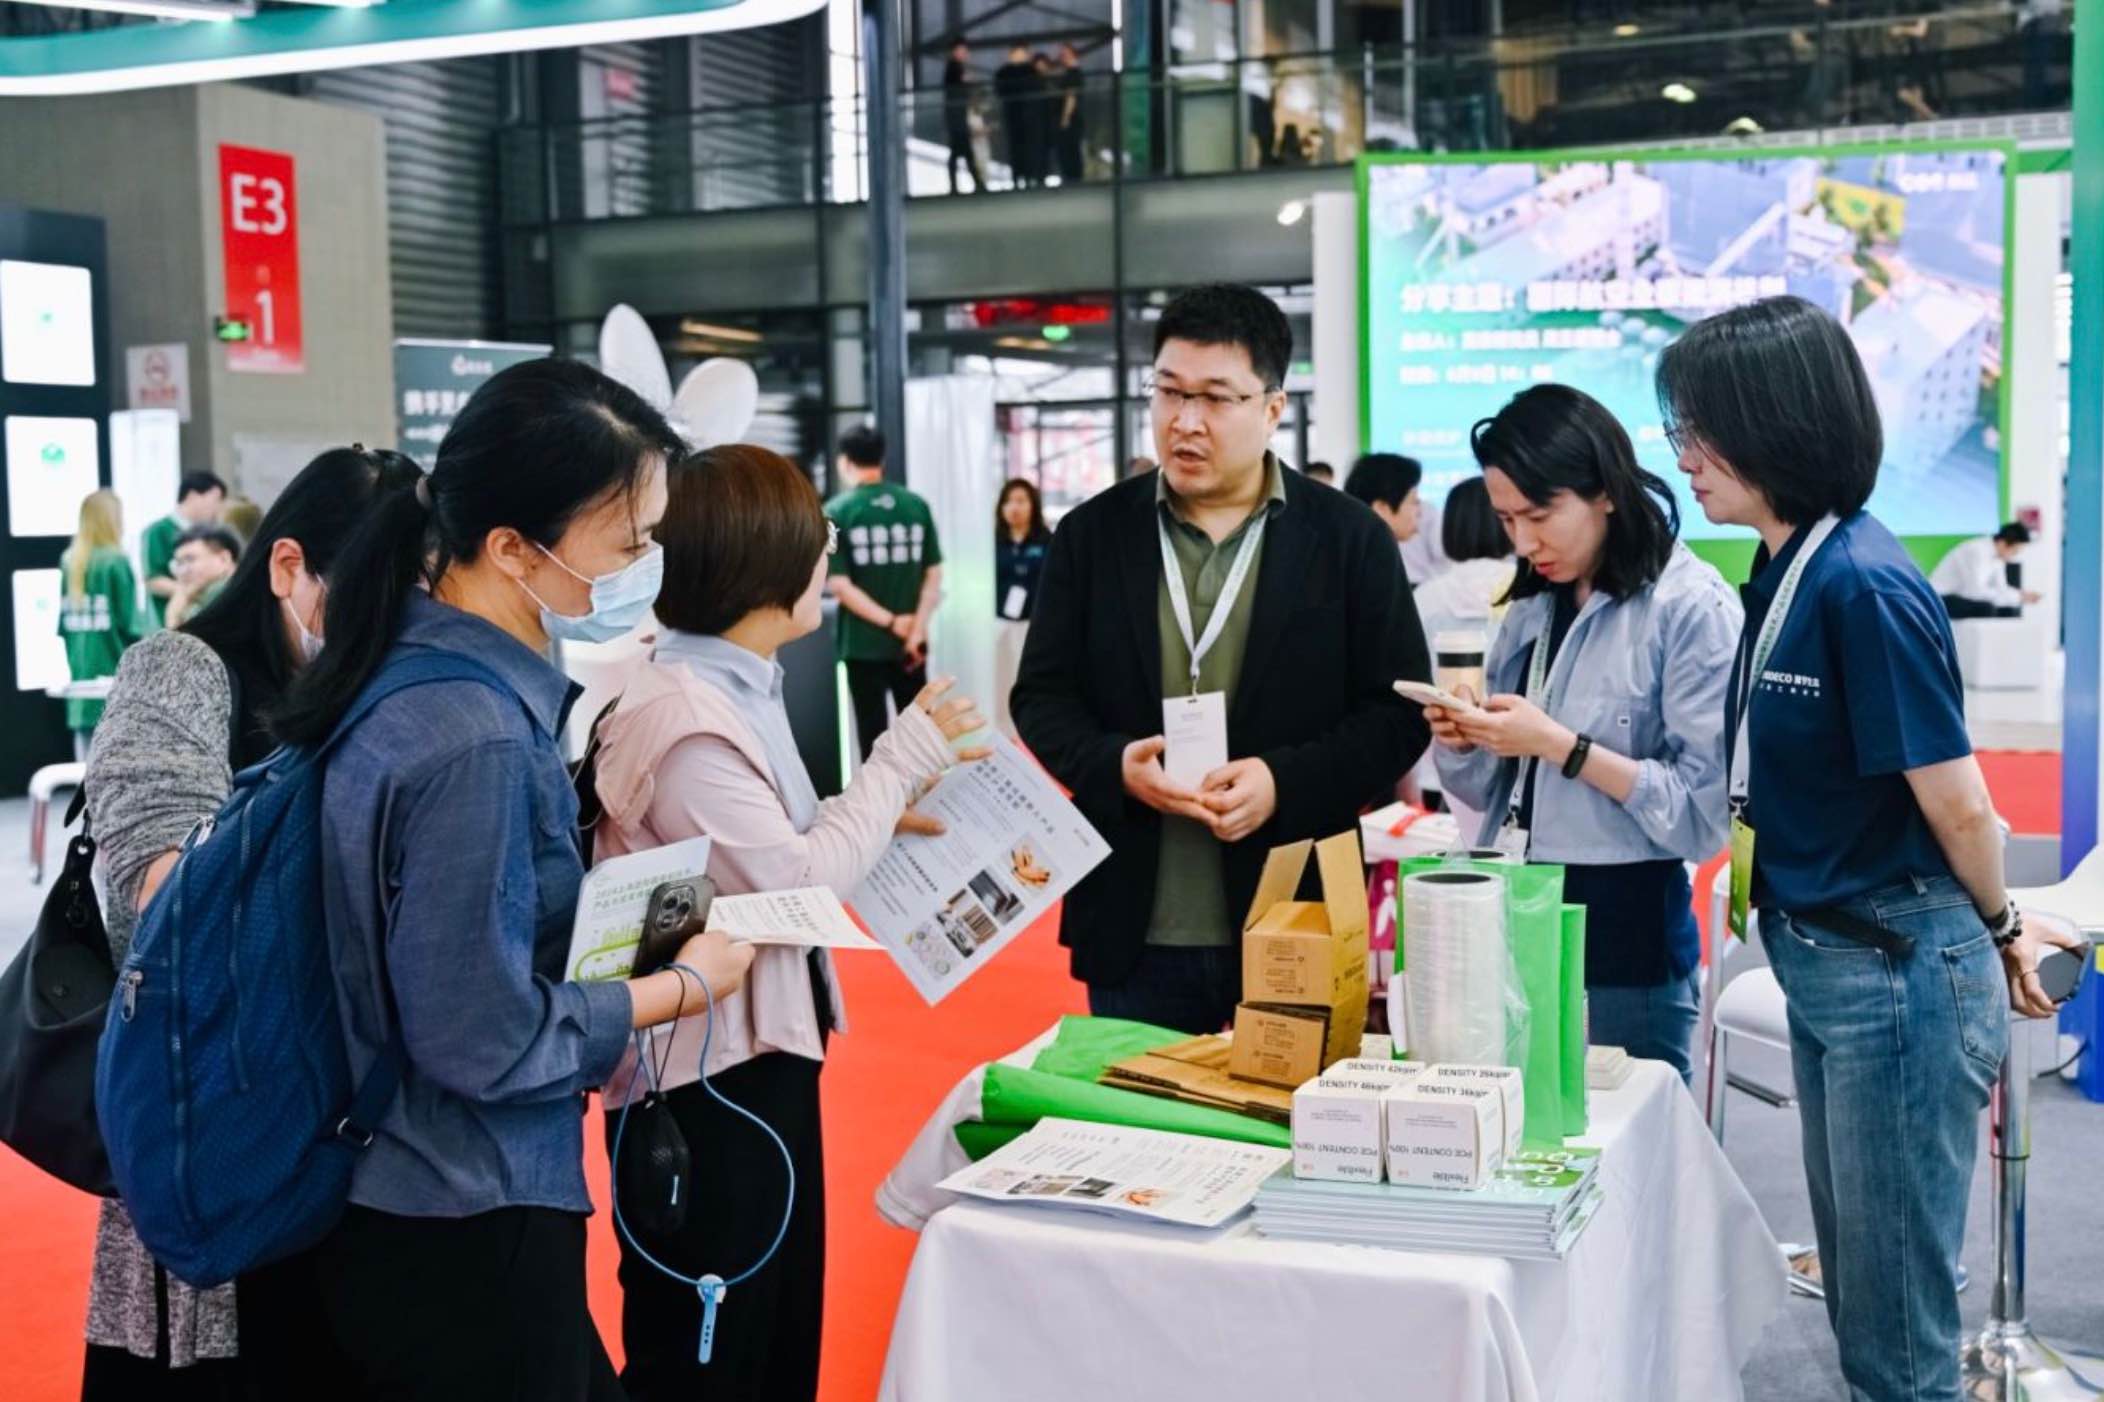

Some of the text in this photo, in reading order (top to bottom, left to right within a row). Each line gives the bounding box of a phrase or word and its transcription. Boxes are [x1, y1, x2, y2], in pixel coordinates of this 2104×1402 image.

[231, 172, 287, 235] E3
[256, 290, 273, 344] 1
[1347, 1063, 1386, 1072] DENSITY
[1438, 1068, 1476, 1077] DENSITY
[1319, 1080, 1358, 1090] DENSITY
[1418, 1085, 1457, 1095] DENSITY
[1318, 1145, 1360, 1155] CONTENT
[1412, 1147, 1453, 1156] CONTENT
